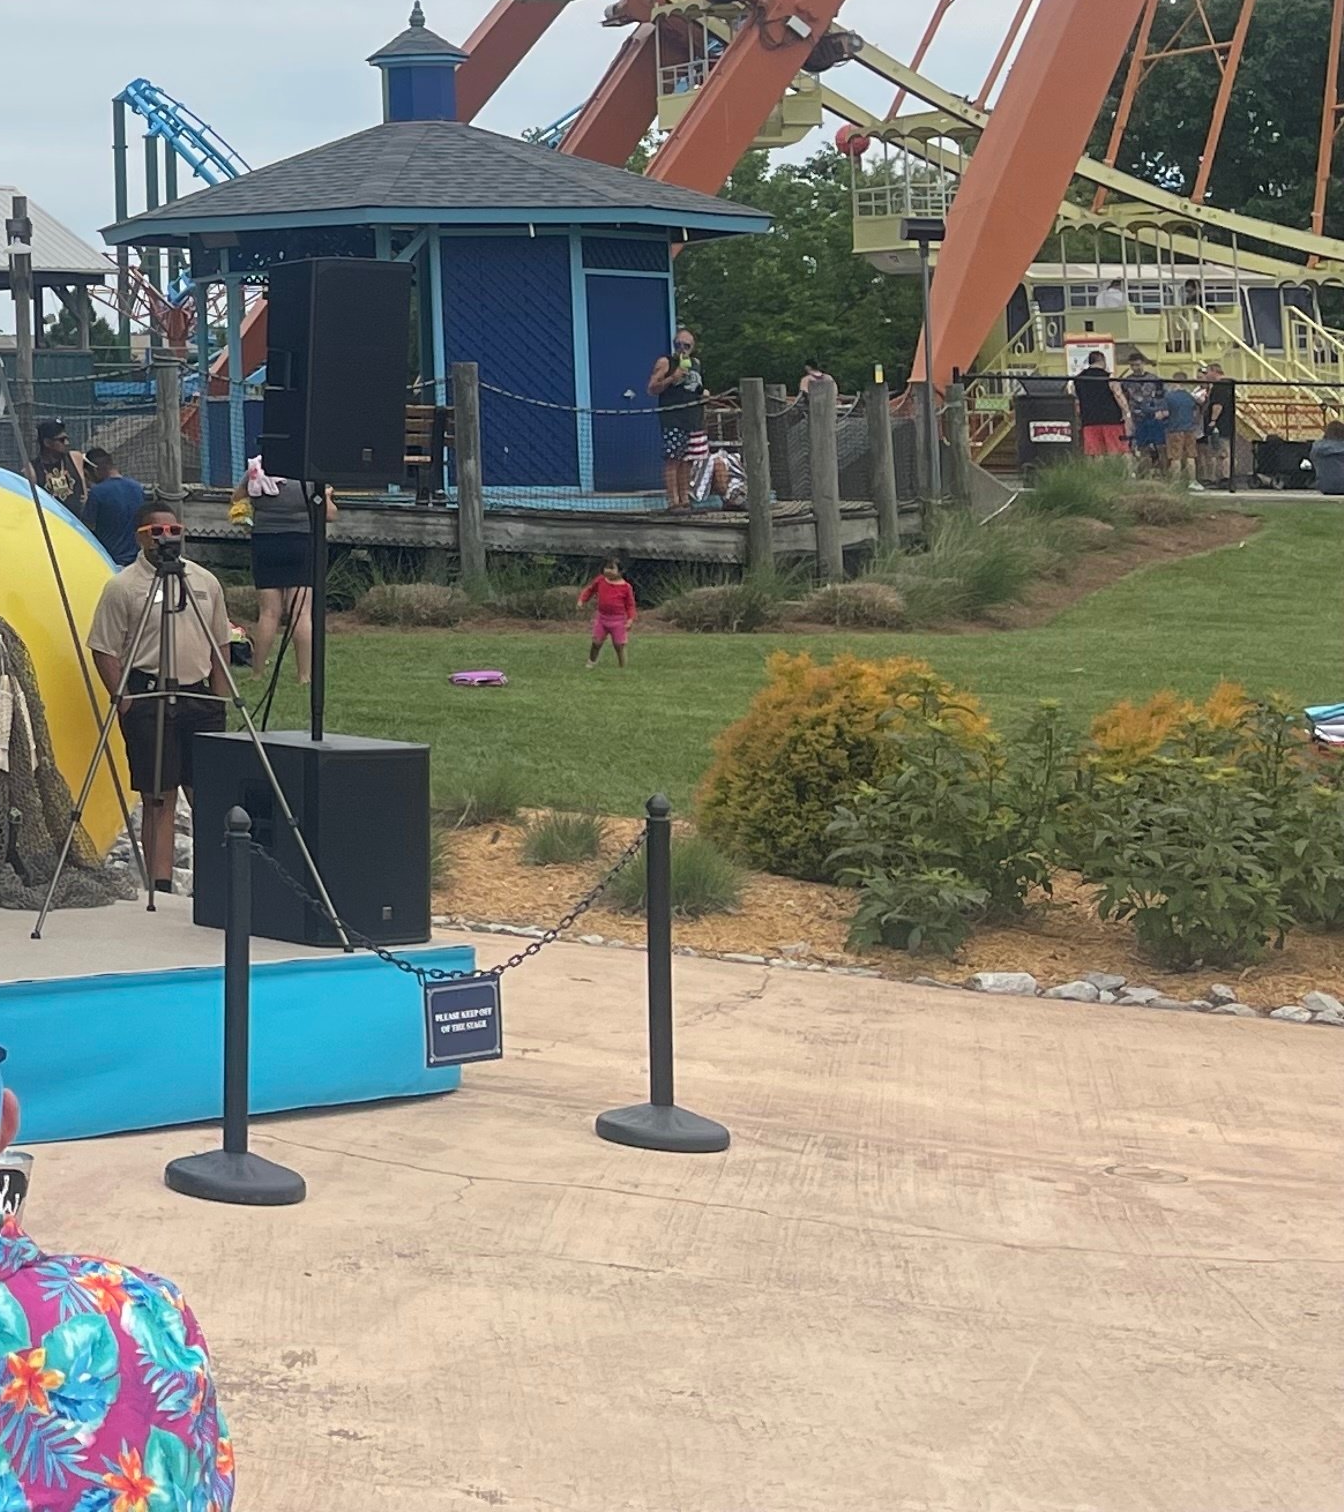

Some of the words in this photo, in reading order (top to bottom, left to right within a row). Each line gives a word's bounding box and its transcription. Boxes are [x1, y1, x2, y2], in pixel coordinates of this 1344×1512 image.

[434, 1011, 460, 1023] PLEASE
[461, 1009, 479, 1019] KEEP
[478, 1007, 493, 1017] OFF
[440, 1024, 451, 1034] OF
[452, 1022, 466, 1033] THE
[466, 1019, 487, 1030] STAGE
